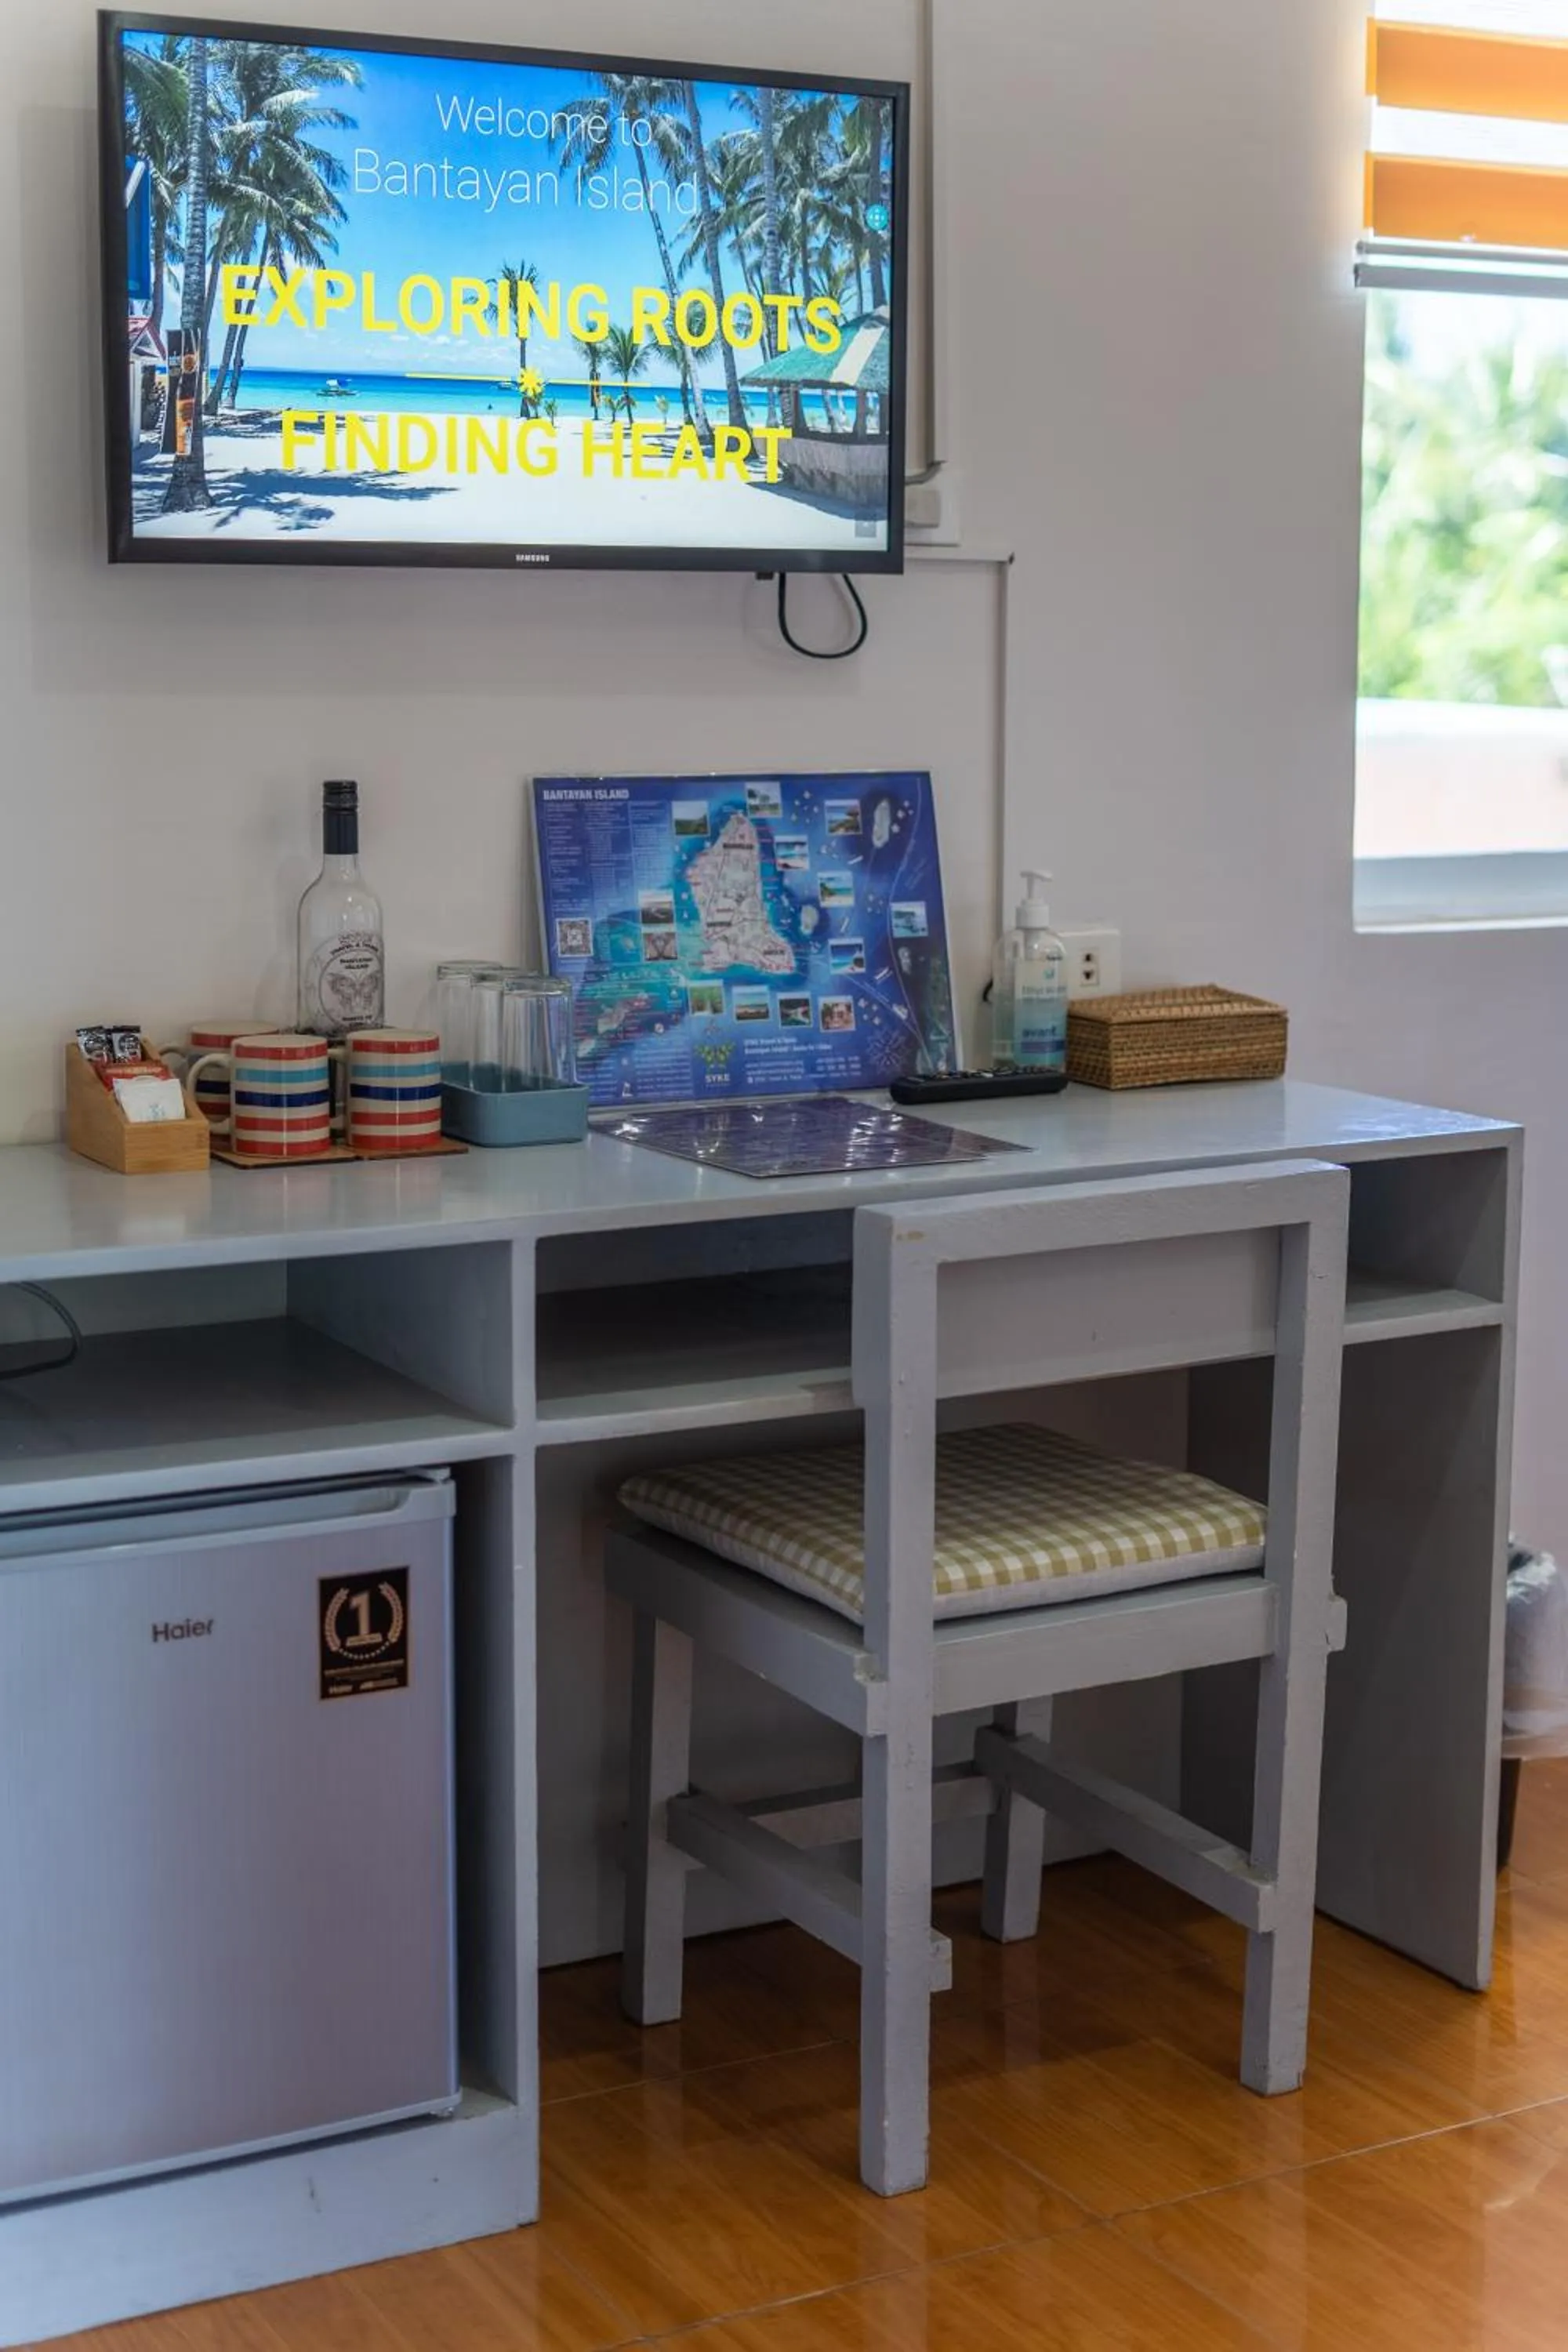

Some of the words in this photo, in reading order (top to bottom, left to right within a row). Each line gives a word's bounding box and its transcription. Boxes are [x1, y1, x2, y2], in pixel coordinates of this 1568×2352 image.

[434, 93, 608, 145] Welcome
[617, 111, 652, 147] to
[354, 148, 559, 212] Bantayan
[577, 165, 699, 214] Island
[223, 265, 608, 343] EXPLORING
[633, 289, 841, 353] ROOTS
[281, 409, 558, 477] FINDING
[583, 420, 793, 484] HEART
[515, 554, 550, 563] SAMSUNG
[594, 788, 630, 800] ISLAND
[151, 1617, 214, 1643] Haier
